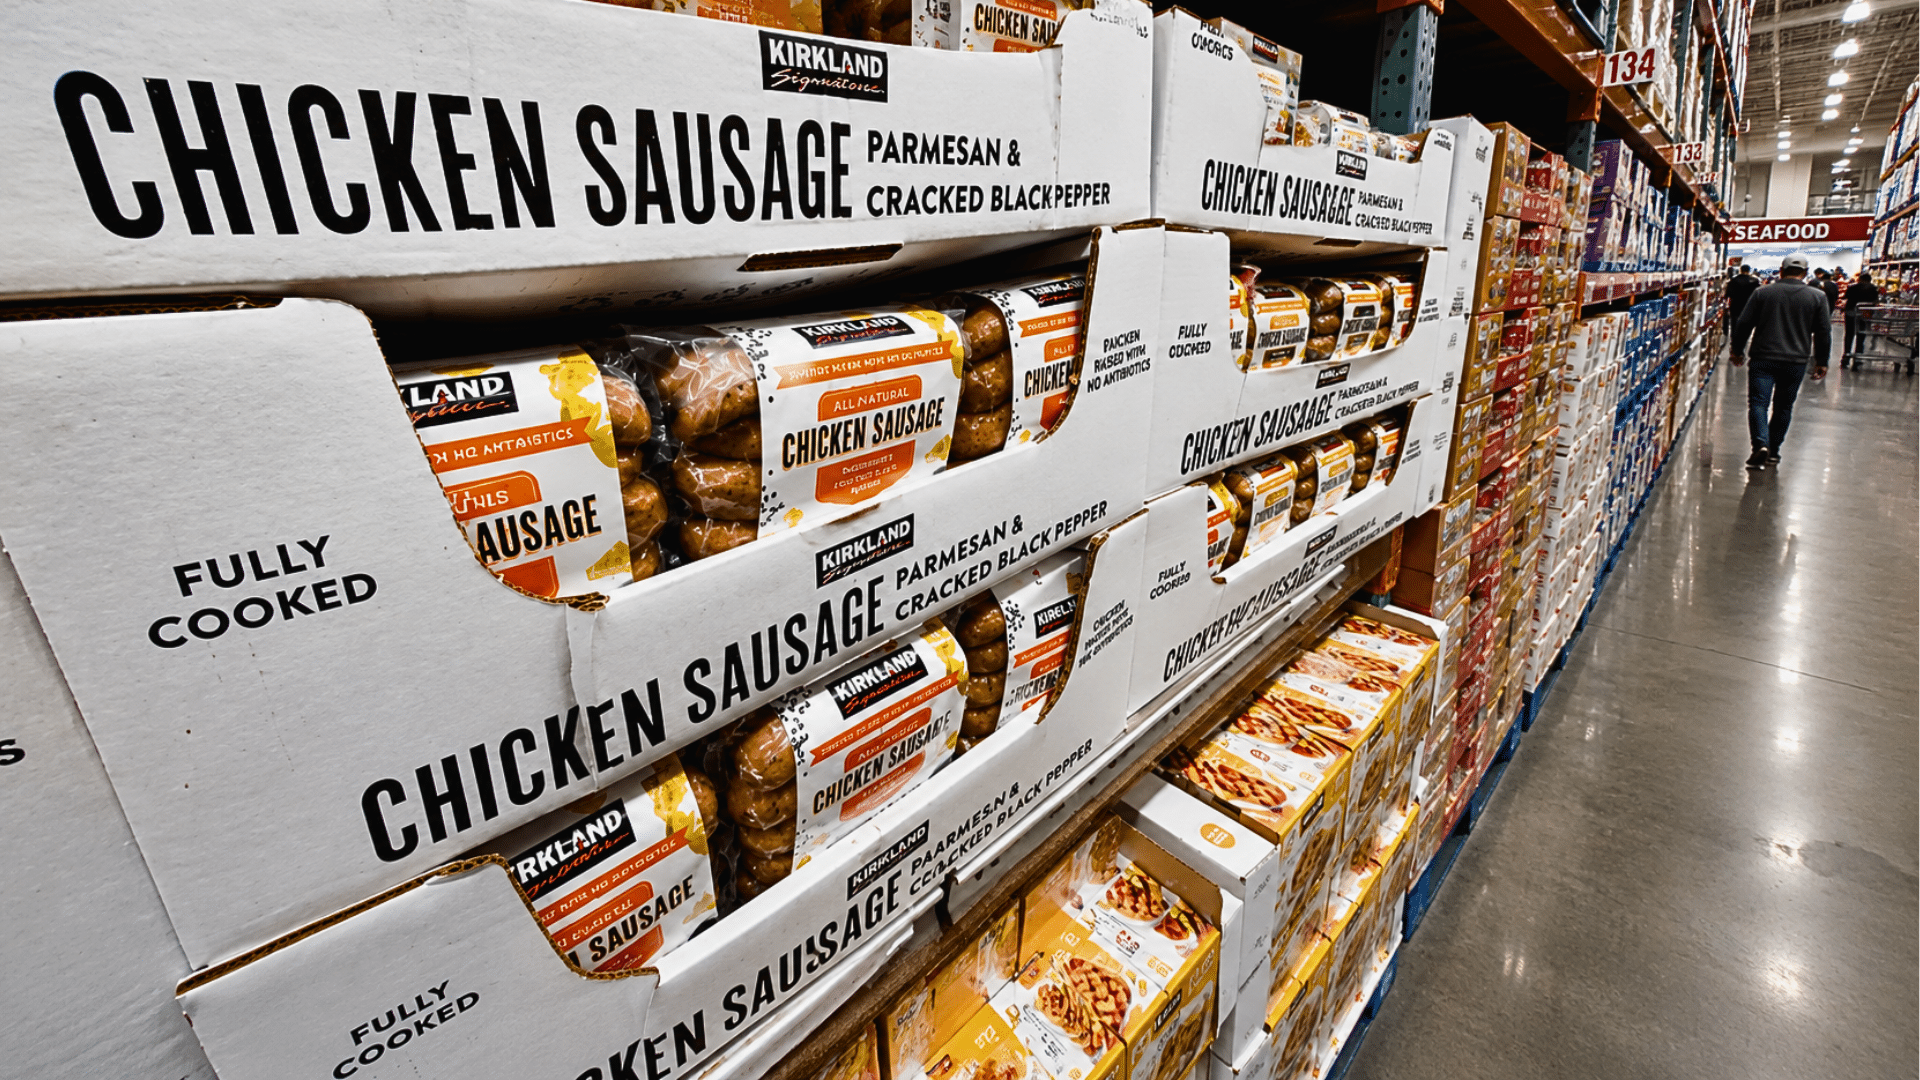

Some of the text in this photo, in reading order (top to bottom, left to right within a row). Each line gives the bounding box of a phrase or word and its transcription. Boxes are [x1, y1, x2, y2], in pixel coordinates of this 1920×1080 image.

[973, 3, 1029, 40] CHICKEN
[768, 39, 884, 79] KIRKLAND
[1608, 48, 1655, 84] 134
[53, 70, 852, 239] CHICKEN SAUSAGE
[867, 130, 1021, 167] PARMESAN &
[866, 182, 1111, 217] CRACKED BLACK PEPPER
[1201, 158, 1278, 217] CHICKEN
[1735, 223, 1830, 241] SEAFOOD
[1178, 323, 1207, 340] FULLY
[834, 387, 909, 412] ALL NATURAL
[1087, 377, 1101, 393] NO
[782, 396, 945, 471] CHICKEN SAUSAGE
[172, 535, 331, 597] FULLY
[822, 519, 912, 571] KIRKLAND
[895, 500, 1109, 622] CRACKED BLACK PEPPER
[896, 514, 1023, 589] PARMESAN &
[148, 572, 378, 649] COOKED
[834, 650, 917, 701] KIRKLAND
[360, 677, 665, 863] CHICKEN
[683, 575, 886, 725] SAUSAGE
[813, 753, 885, 815] CHICKEN
[997, 780, 1043, 828] BLACK
[589, 874, 695, 962] SAUSAGE
[333, 992, 479, 1079] COOKED
[350, 979, 449, 1046] FULLY
